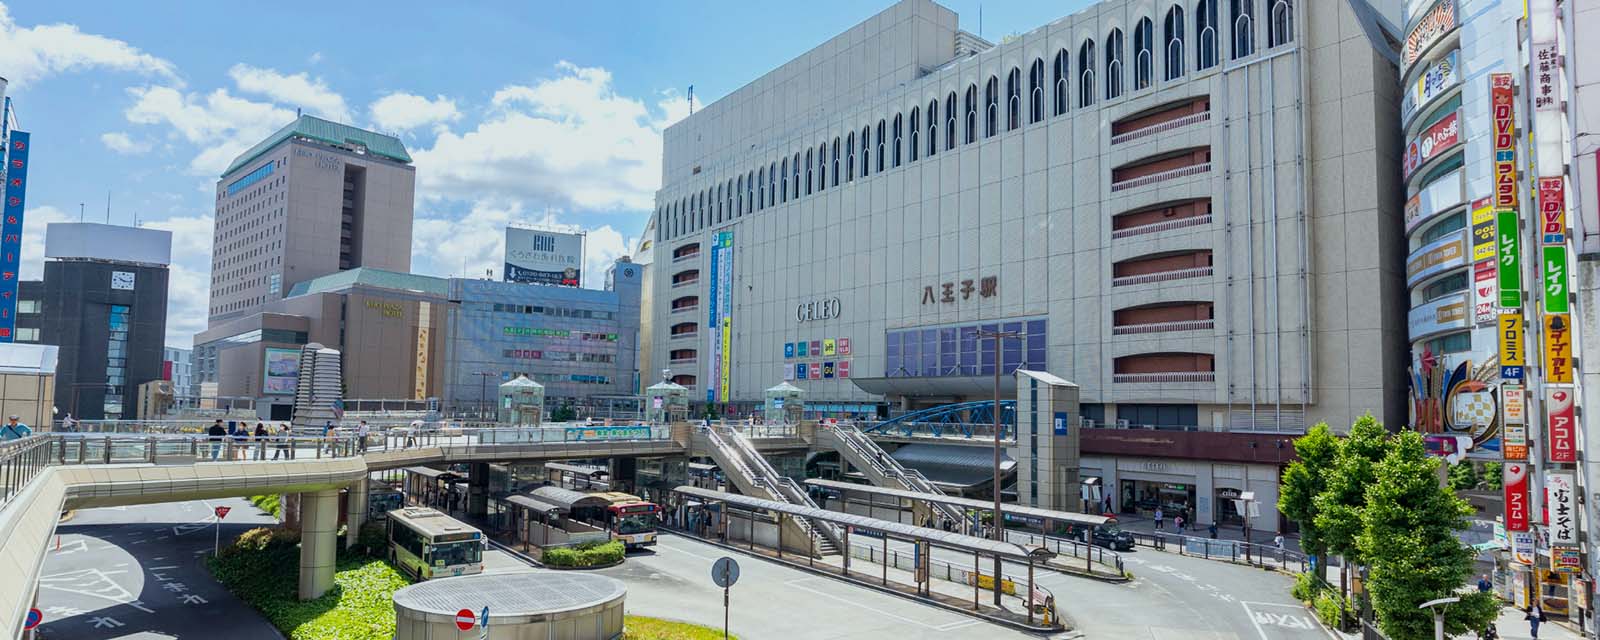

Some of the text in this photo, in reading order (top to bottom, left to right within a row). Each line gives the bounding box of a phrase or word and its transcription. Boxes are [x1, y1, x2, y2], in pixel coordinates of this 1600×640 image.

[1496, 105, 1513, 149] DVD
[1544, 202, 1562, 233] DVD
[1502, 233, 1515, 266] レイク
[922, 275, 998, 305] 八王子駅
[1547, 261, 1563, 296] レイク
[797, 297, 842, 322] CELEO
[1504, 319, 1519, 362] プロミス
[1504, 367, 1519, 377] 4F
[1554, 416, 1570, 450] アコム
[1556, 452, 1569, 460] 2F
[1511, 492, 1522, 520] アコム
[1554, 489, 1574, 541] 富士そば
